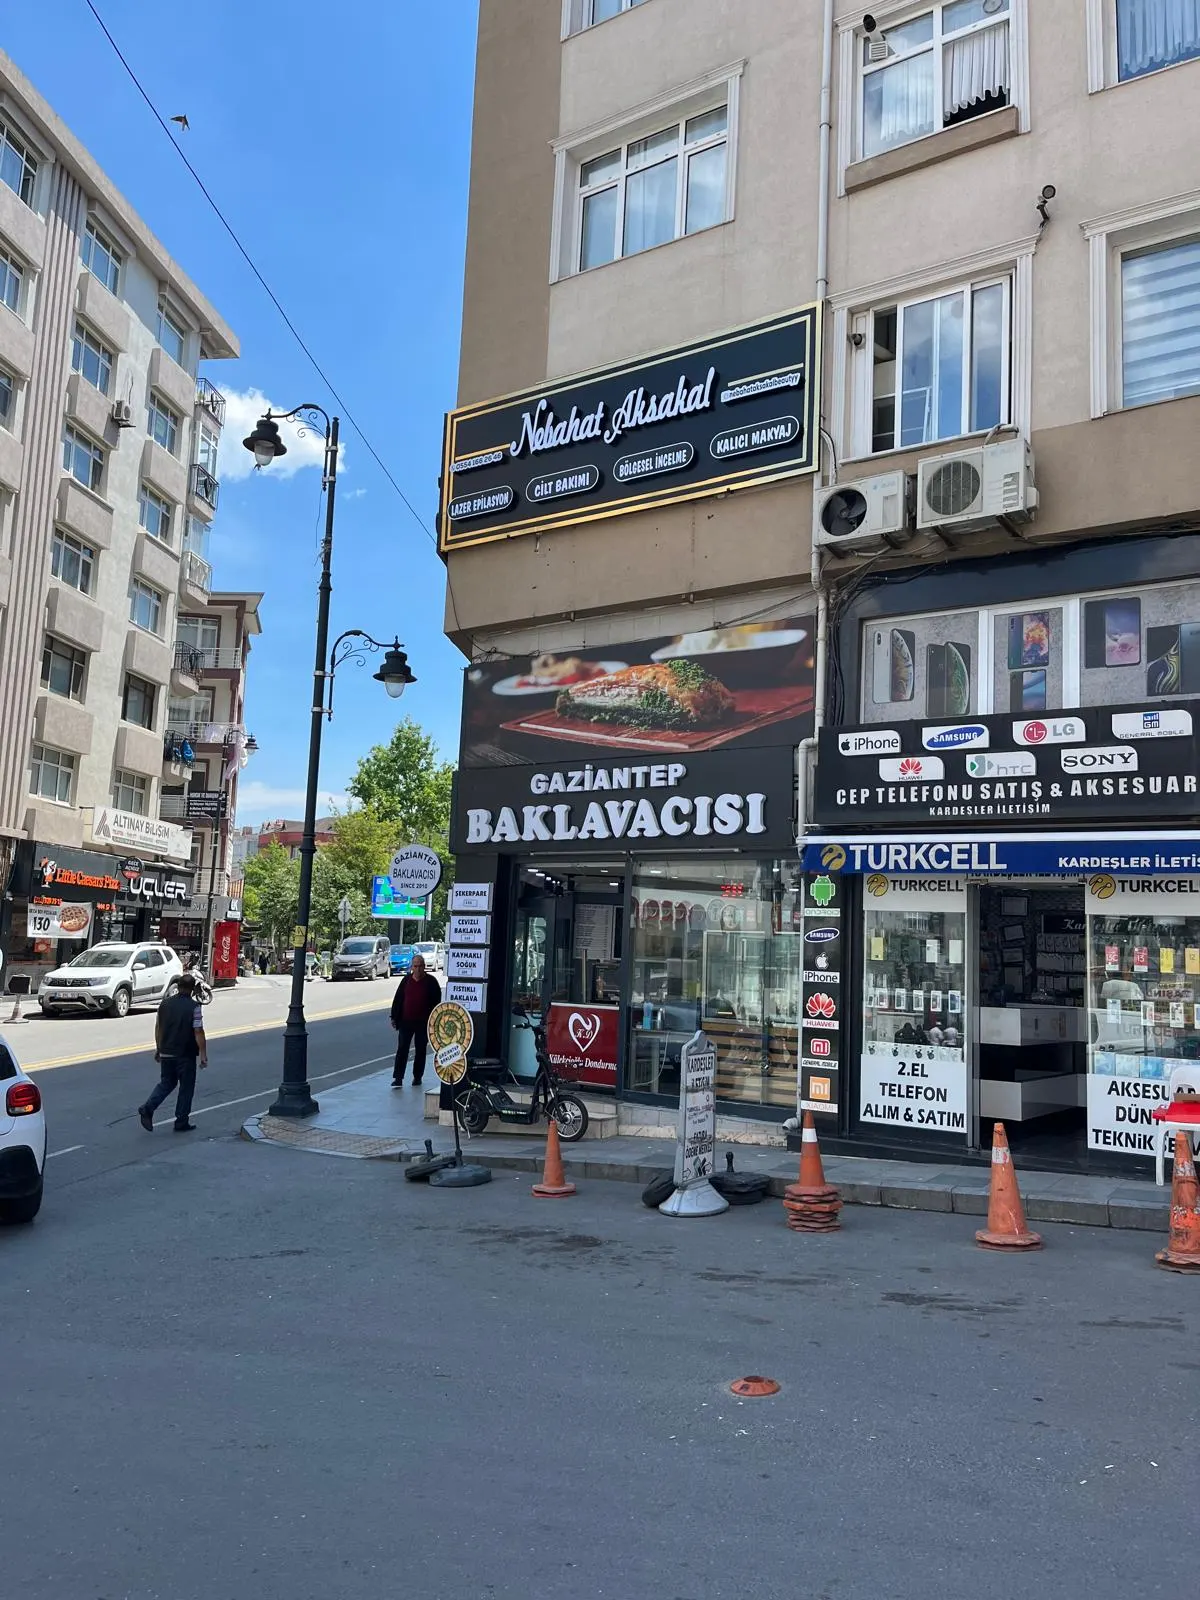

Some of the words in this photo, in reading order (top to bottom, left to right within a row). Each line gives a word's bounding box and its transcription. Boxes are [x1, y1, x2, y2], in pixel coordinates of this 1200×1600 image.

[510, 398, 604, 456] Nebahat
[604, 366, 716, 444] Aksakal
[716, 434, 748, 454] KALICI
[751, 422, 792, 446] MAKYAJ
[619, 458, 655, 478] BÖLGESEL
[655, 449, 687, 470] İNCELME
[534, 480, 554, 497] CİLT
[555, 472, 590, 493] BAKIMI
[451, 502, 471, 517] LAZER
[472, 492, 509, 512] EPİLASYON
[933, 732, 978, 743] SAMSUNG
[1052, 723, 1075, 737] LG
[854, 737, 899, 751] iPhone
[1063, 752, 1135, 768] SONY
[530, 763, 687, 795] GAZİANTEP
[836, 788, 870, 805] CEP
[876, 784, 973, 804] TELEFONU
[980, 781, 1043, 801] SATIŞ
[1050, 783, 1063, 797] &
[1070, 775, 1197, 797] AKSESUAR
[113, 814, 145, 832] ALTINAY
[465, 793, 767, 844] BAKLAVACISI
[849, 843, 1007, 870] TURKCELL
[1058, 857, 1151, 869] KARDEŞLER
[55, 867, 76, 884] Little
[393, 868, 436, 881] BAKLAVACISI
[890, 880, 964, 892] TURKCELL
[33, 916, 51, 931] 130
[456, 960, 477, 968] SOĞUK
[804, 972, 838, 983] iPhone
[453, 985, 476, 993] FISTIKLI
[450, 994, 478, 1002] BAKLAVA
[806, 1020, 836, 1028] HUAWEI
[802, 1059, 820, 1067] GENERAL
[898, 1061, 929, 1078] 2.EL
[879, 1082, 948, 1102] TELEFON
[863, 1103, 899, 1121] ALIM
[903, 1107, 914, 1122] &
[917, 1109, 965, 1128] SATIM
